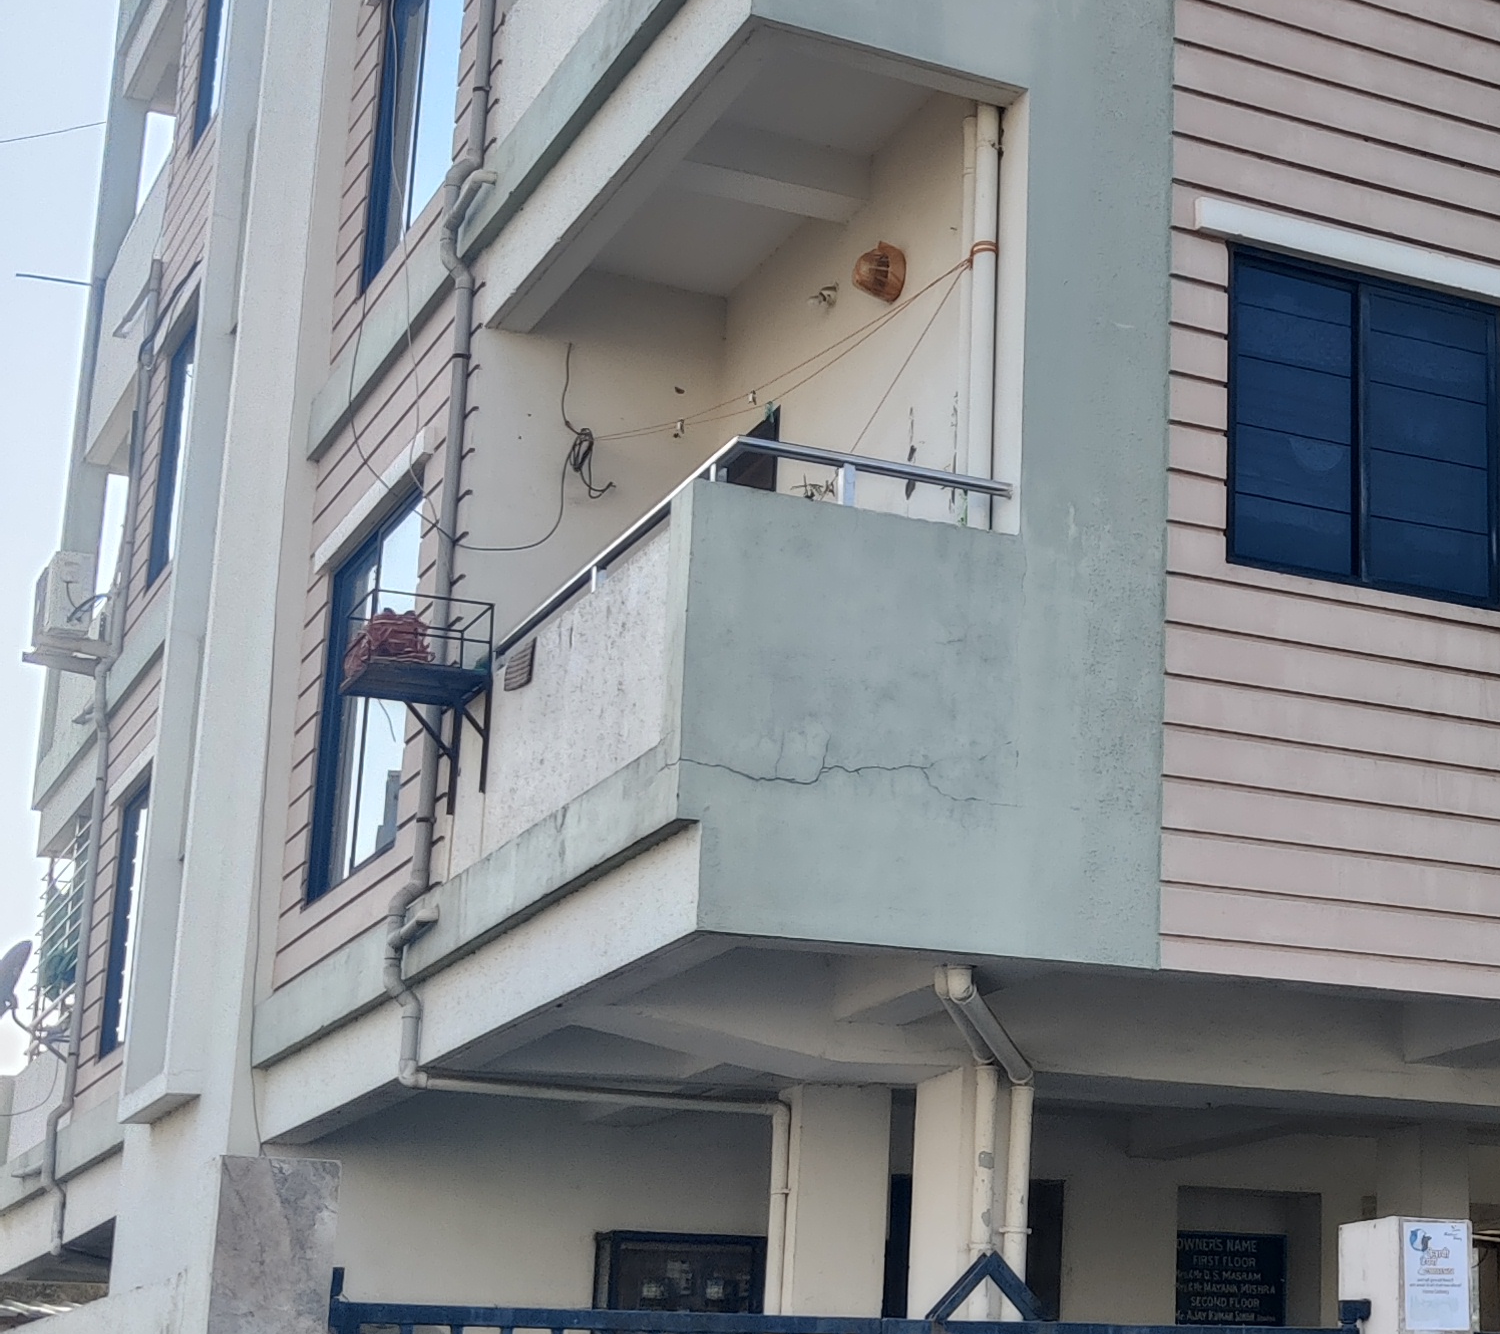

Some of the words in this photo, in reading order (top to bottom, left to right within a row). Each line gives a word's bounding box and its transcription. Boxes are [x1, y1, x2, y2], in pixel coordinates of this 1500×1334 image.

[1227, 1239, 1257, 1253] NAME
[1193, 1255, 1219, 1266] FIRST
[1222, 1256, 1256, 1267] FLOOR
[1191, 1296, 1227, 1307] SECOND
[1229, 1297, 1260, 1308] FLOOR
